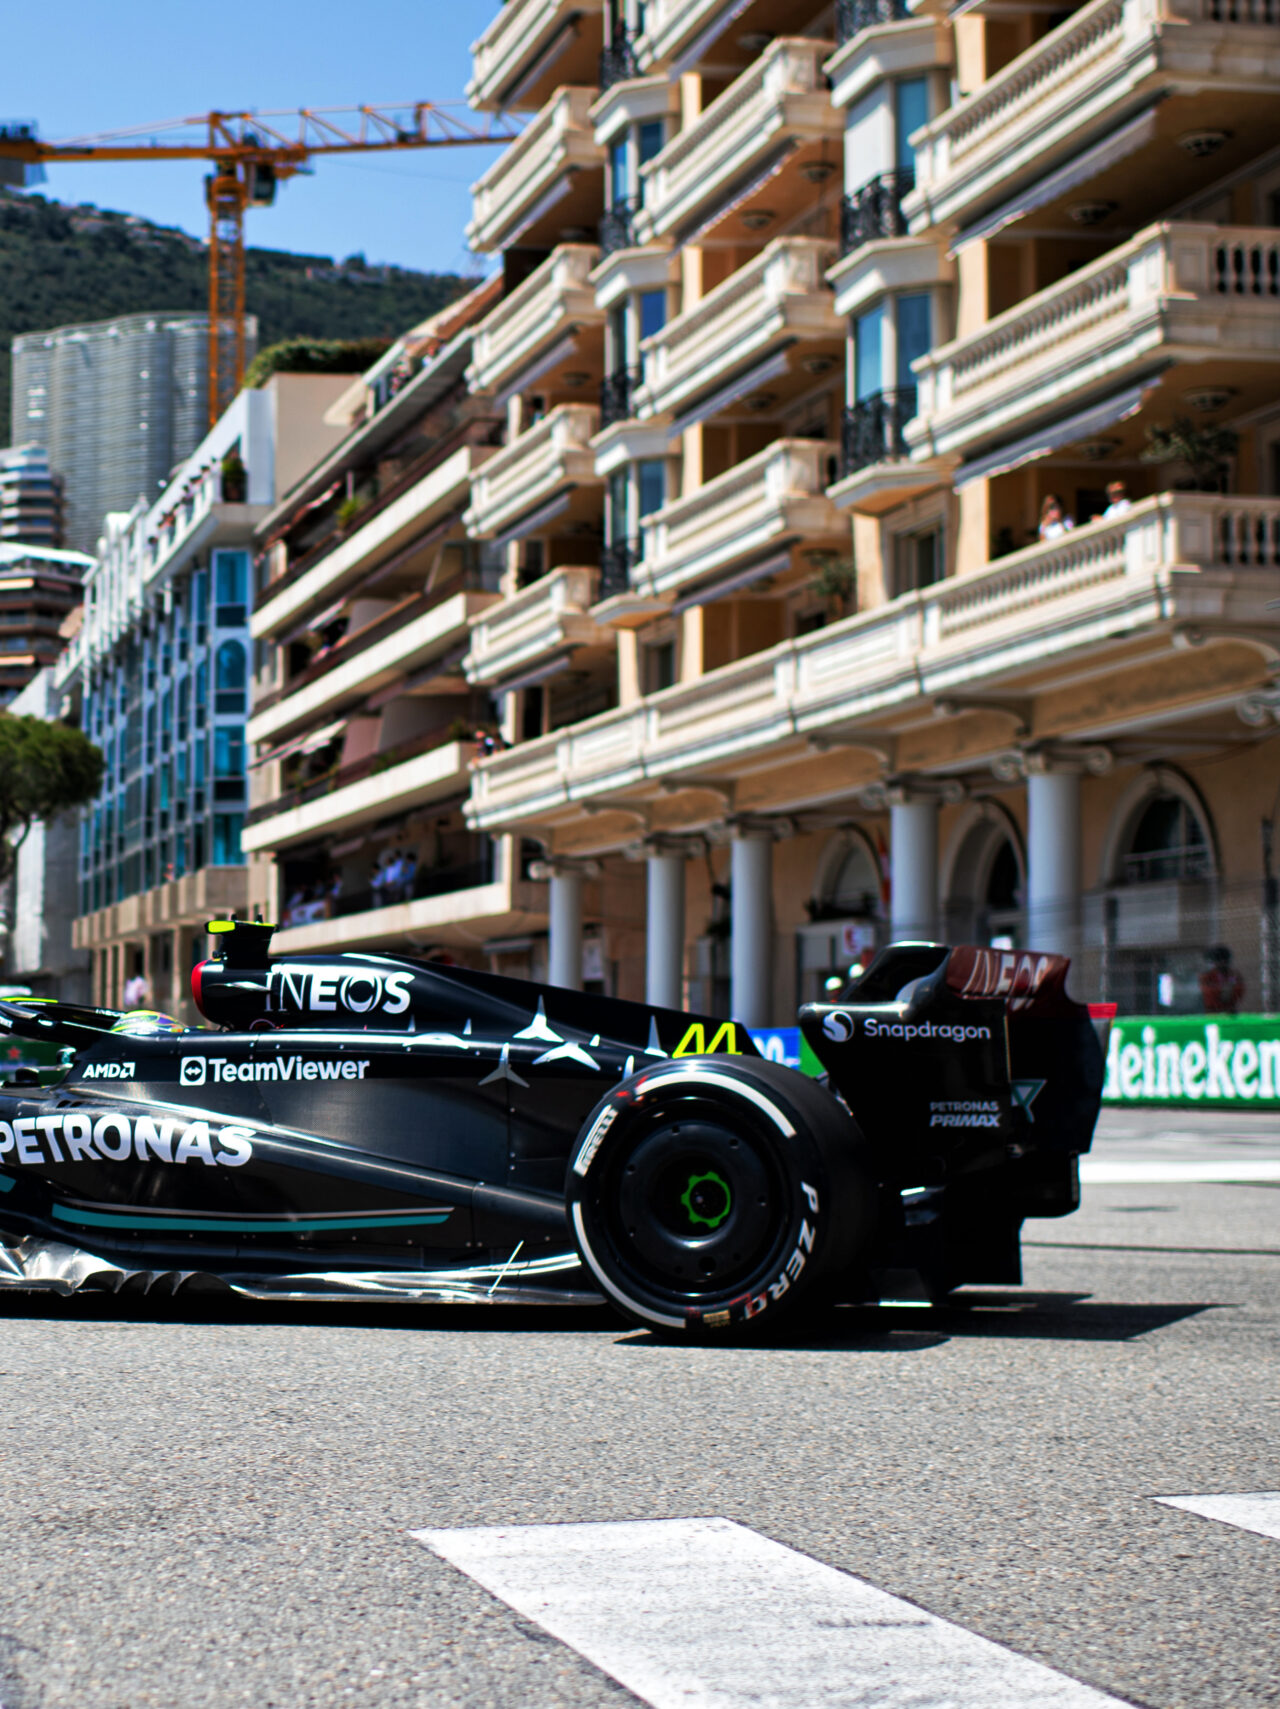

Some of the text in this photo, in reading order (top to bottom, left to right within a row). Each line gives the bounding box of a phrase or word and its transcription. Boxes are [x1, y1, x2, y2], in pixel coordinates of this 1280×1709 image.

[264, 968, 415, 1014] INEOS
[672, 1022, 743, 1059] 44
[863, 1018, 992, 1042] Snapdragon
[82, 1063, 120, 1079] AMD
[208, 1056, 370, 1082] TeamViewer
[930, 1101, 1000, 1112] PETRONAS
[929, 1114, 1002, 1127] PRIMAX
[572, 1103, 619, 1177] PIRELLI
[744, 1180, 819, 1320] P ZERO
